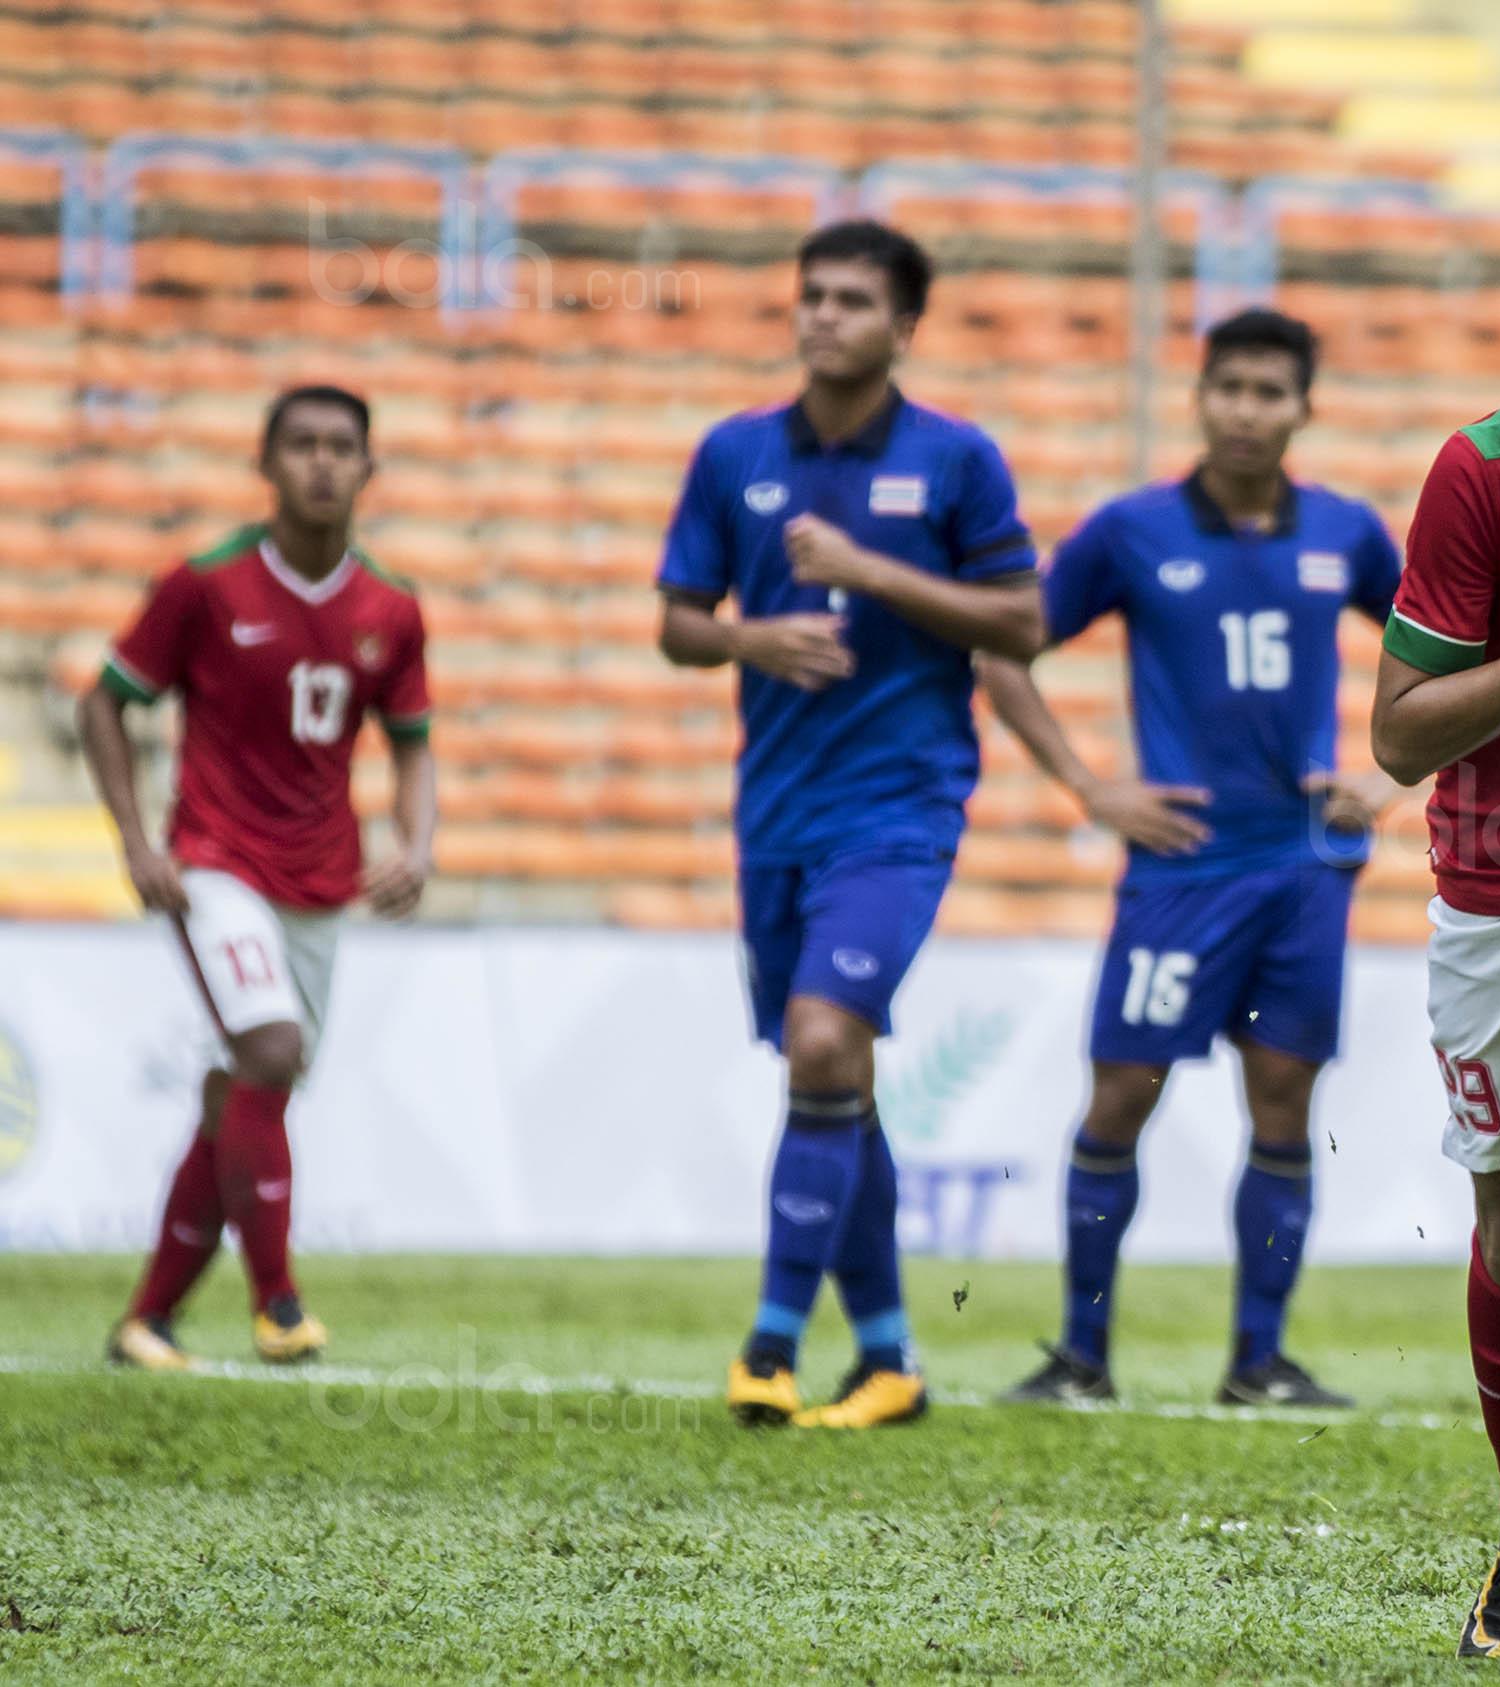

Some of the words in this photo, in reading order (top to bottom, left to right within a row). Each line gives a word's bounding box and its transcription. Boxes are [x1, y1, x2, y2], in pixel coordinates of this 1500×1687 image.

[1219, 608, 1292, 692] 16
[288, 660, 353, 745] 13
[1122, 945, 1198, 1027] 16
